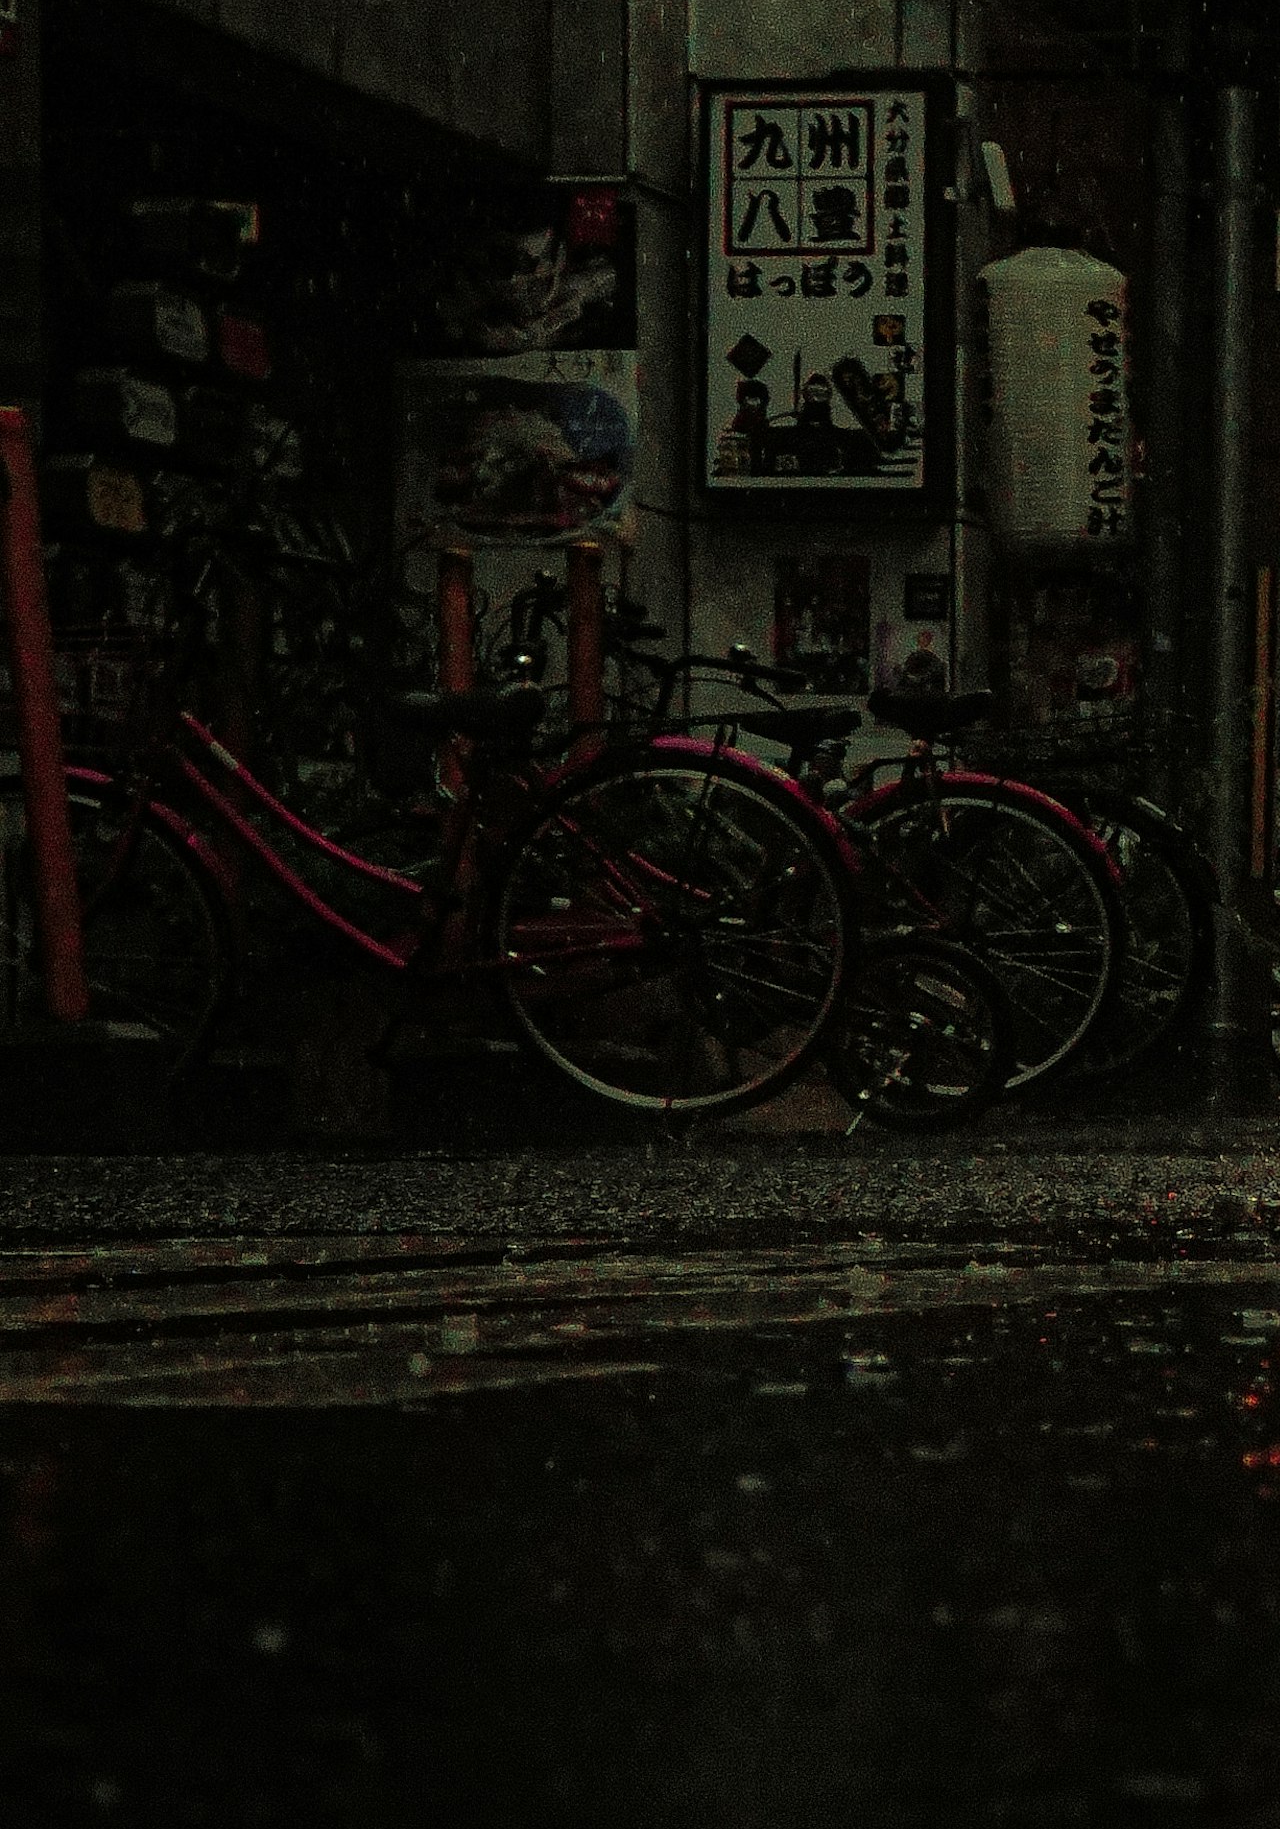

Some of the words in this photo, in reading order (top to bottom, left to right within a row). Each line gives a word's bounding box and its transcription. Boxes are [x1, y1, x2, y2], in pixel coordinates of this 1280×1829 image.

[740, 114, 860, 169] 九州
[739, 184, 861, 242] 八豊
[727, 257, 874, 298] はっぽう
